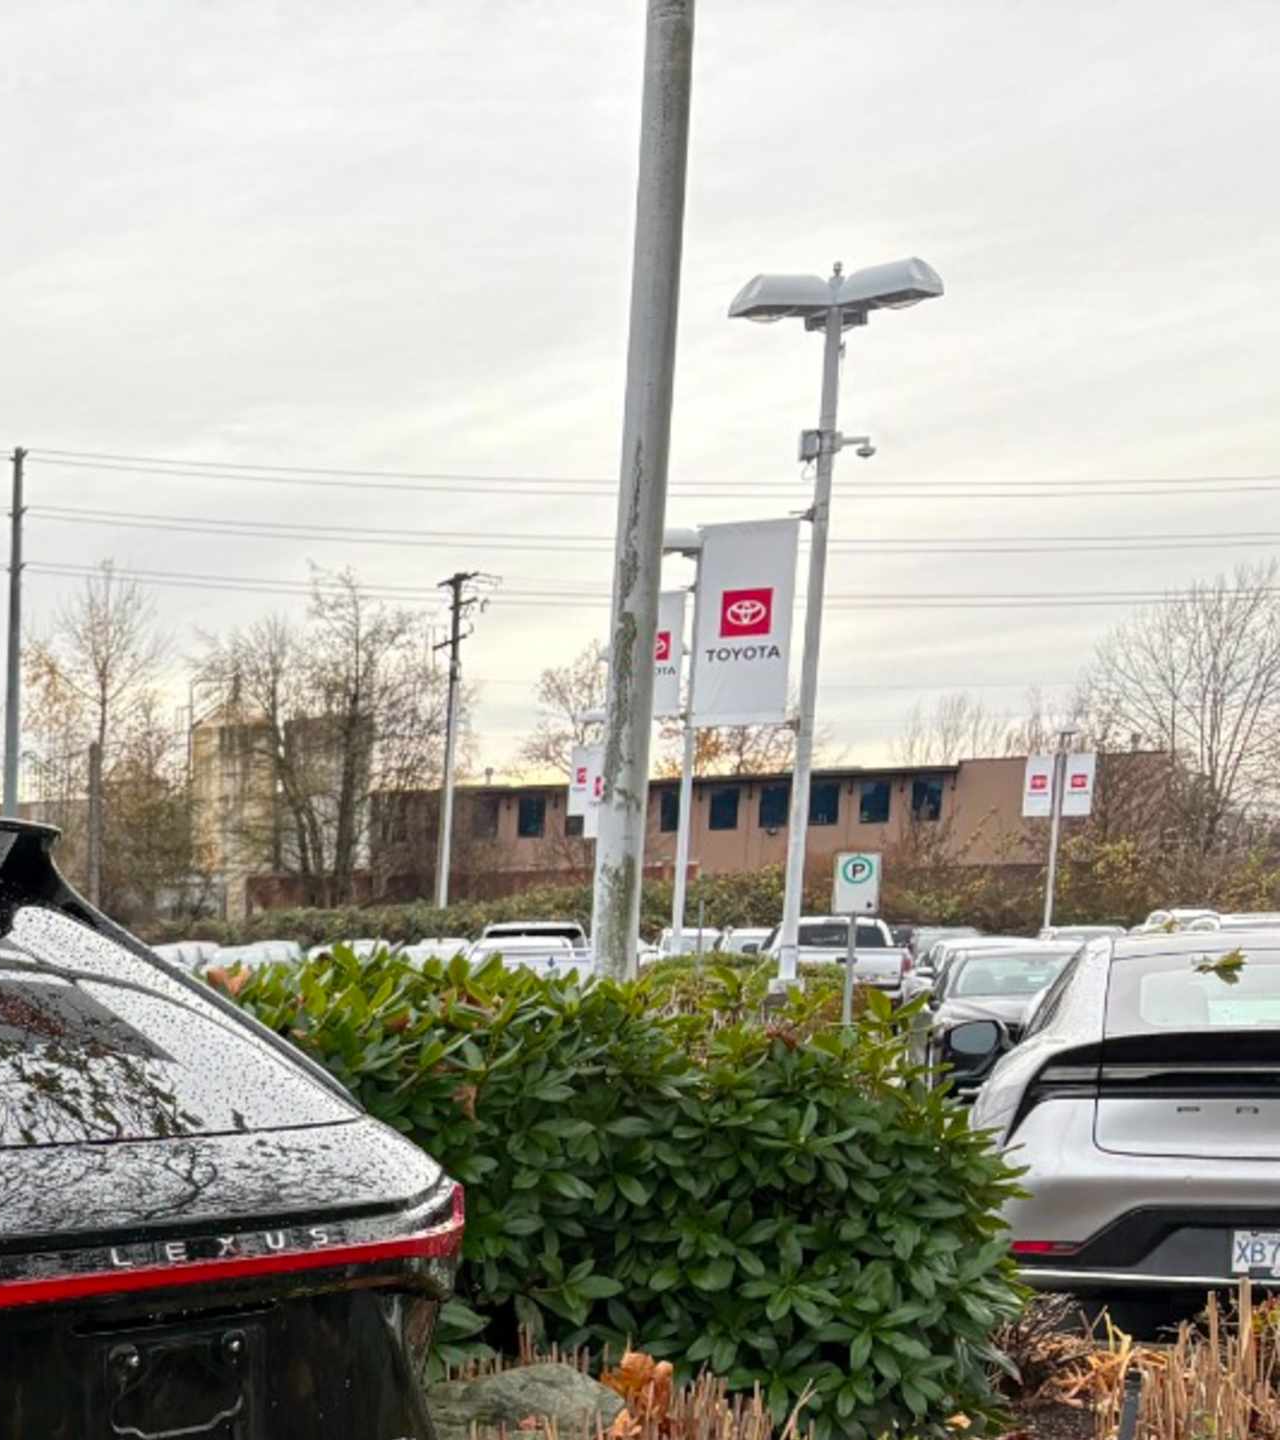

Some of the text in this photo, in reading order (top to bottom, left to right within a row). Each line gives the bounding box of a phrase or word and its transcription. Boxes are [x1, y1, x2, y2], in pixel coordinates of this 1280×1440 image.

[705, 645, 781, 662] TOYOTA
[852, 863, 866, 879] P
[110, 1227, 329, 1267] LEXUS
